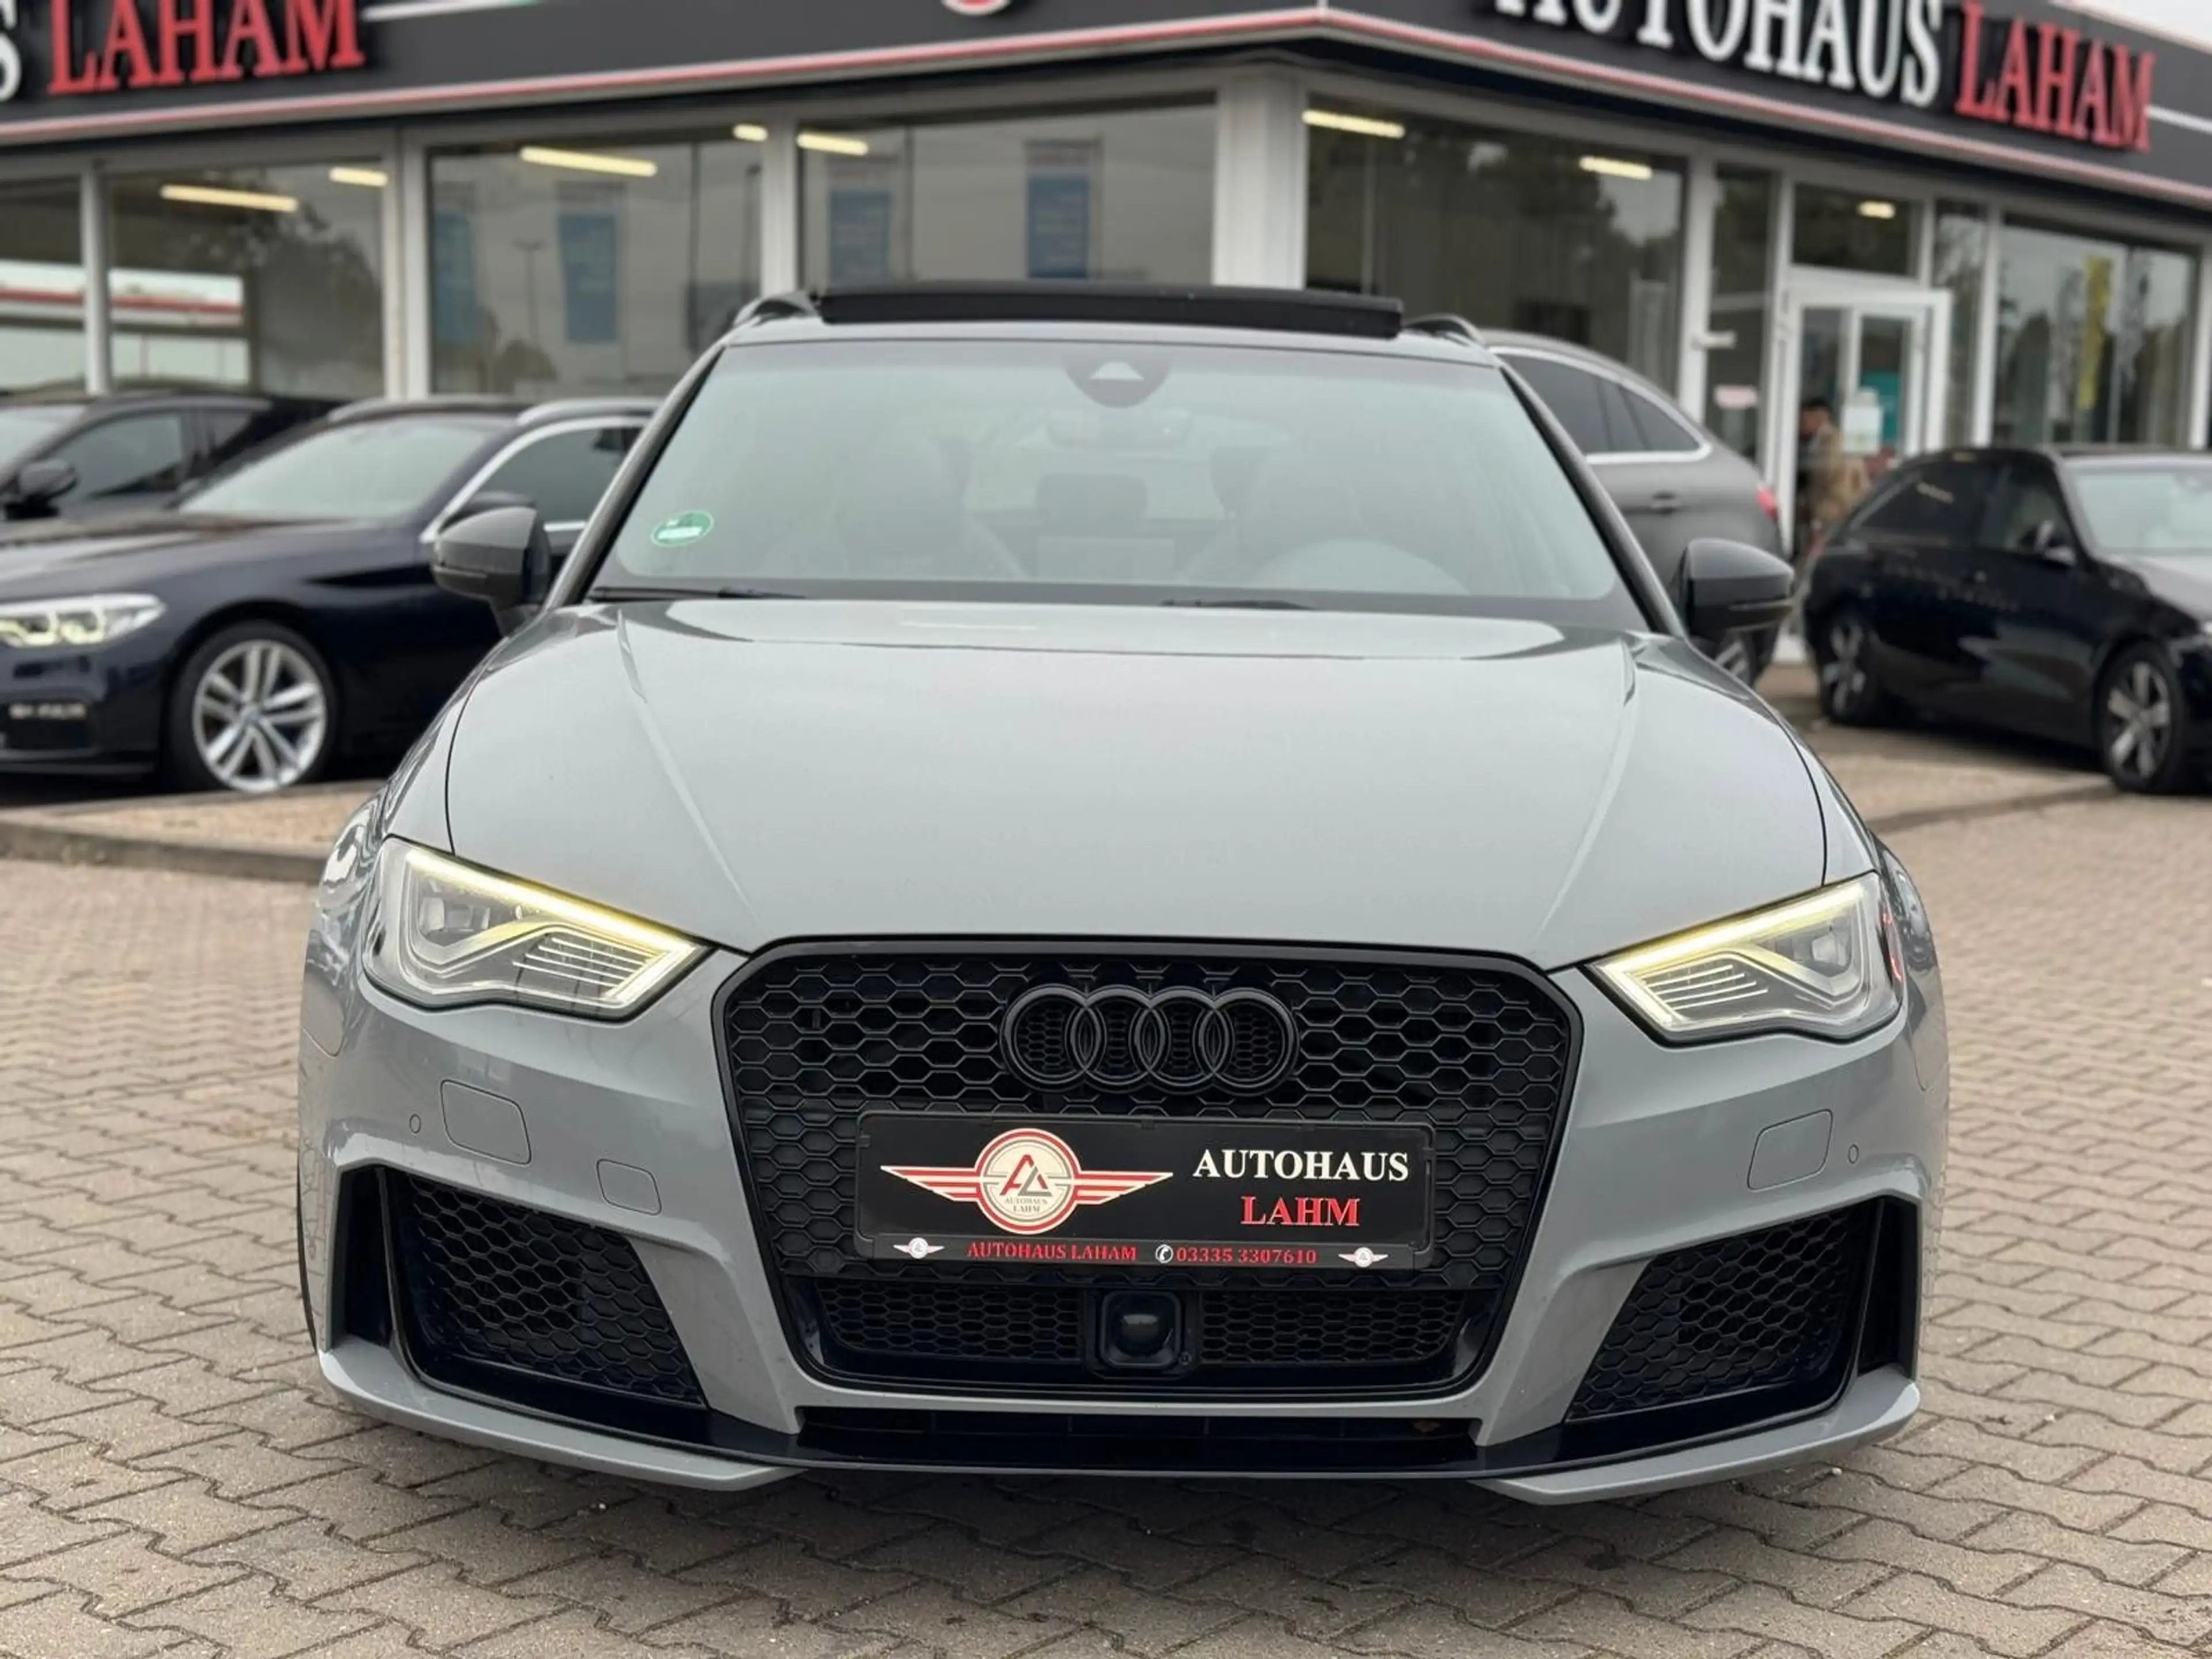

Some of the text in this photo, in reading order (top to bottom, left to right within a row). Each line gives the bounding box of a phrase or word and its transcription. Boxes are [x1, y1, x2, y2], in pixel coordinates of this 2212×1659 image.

[46, 0, 366, 94] LAHAM
[1494, 0, 2157, 151] OHAUS LAHAM
[1193, 1149, 1409, 1181] AUTOHAUS
[1240, 1196, 1360, 1226] LAHM
[967, 1241, 1137, 1261] AUTOHAUS LAHAM
[1176, 1247, 1317, 1263] 03335 3307610
